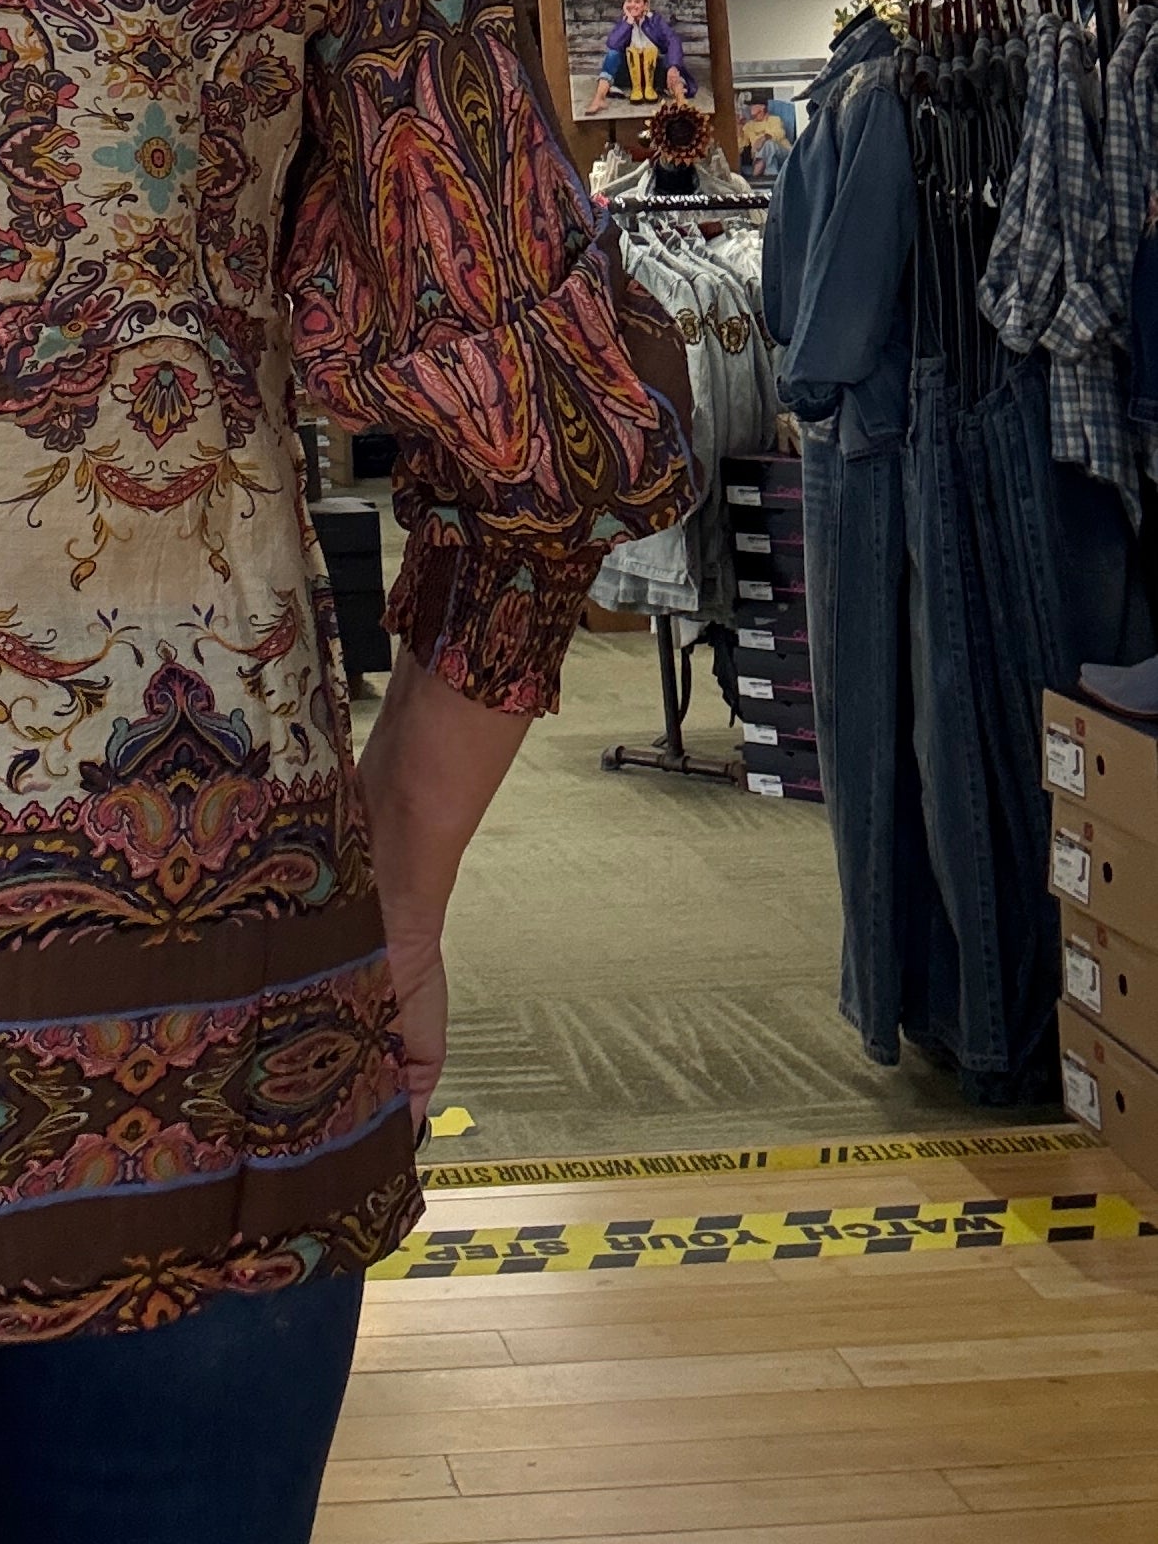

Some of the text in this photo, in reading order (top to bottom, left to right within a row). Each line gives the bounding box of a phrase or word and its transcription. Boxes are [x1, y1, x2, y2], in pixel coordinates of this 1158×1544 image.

[853, 1141, 912, 1162] STEP
[915, 1138, 975, 1159] YOUR
[975, 1135, 1057, 1156] WATCH
[436, 1153, 736, 1186] CAUTION WATCH YOUR STEP
[425, 1216, 1005, 1262] WATCH YOUR STEP
